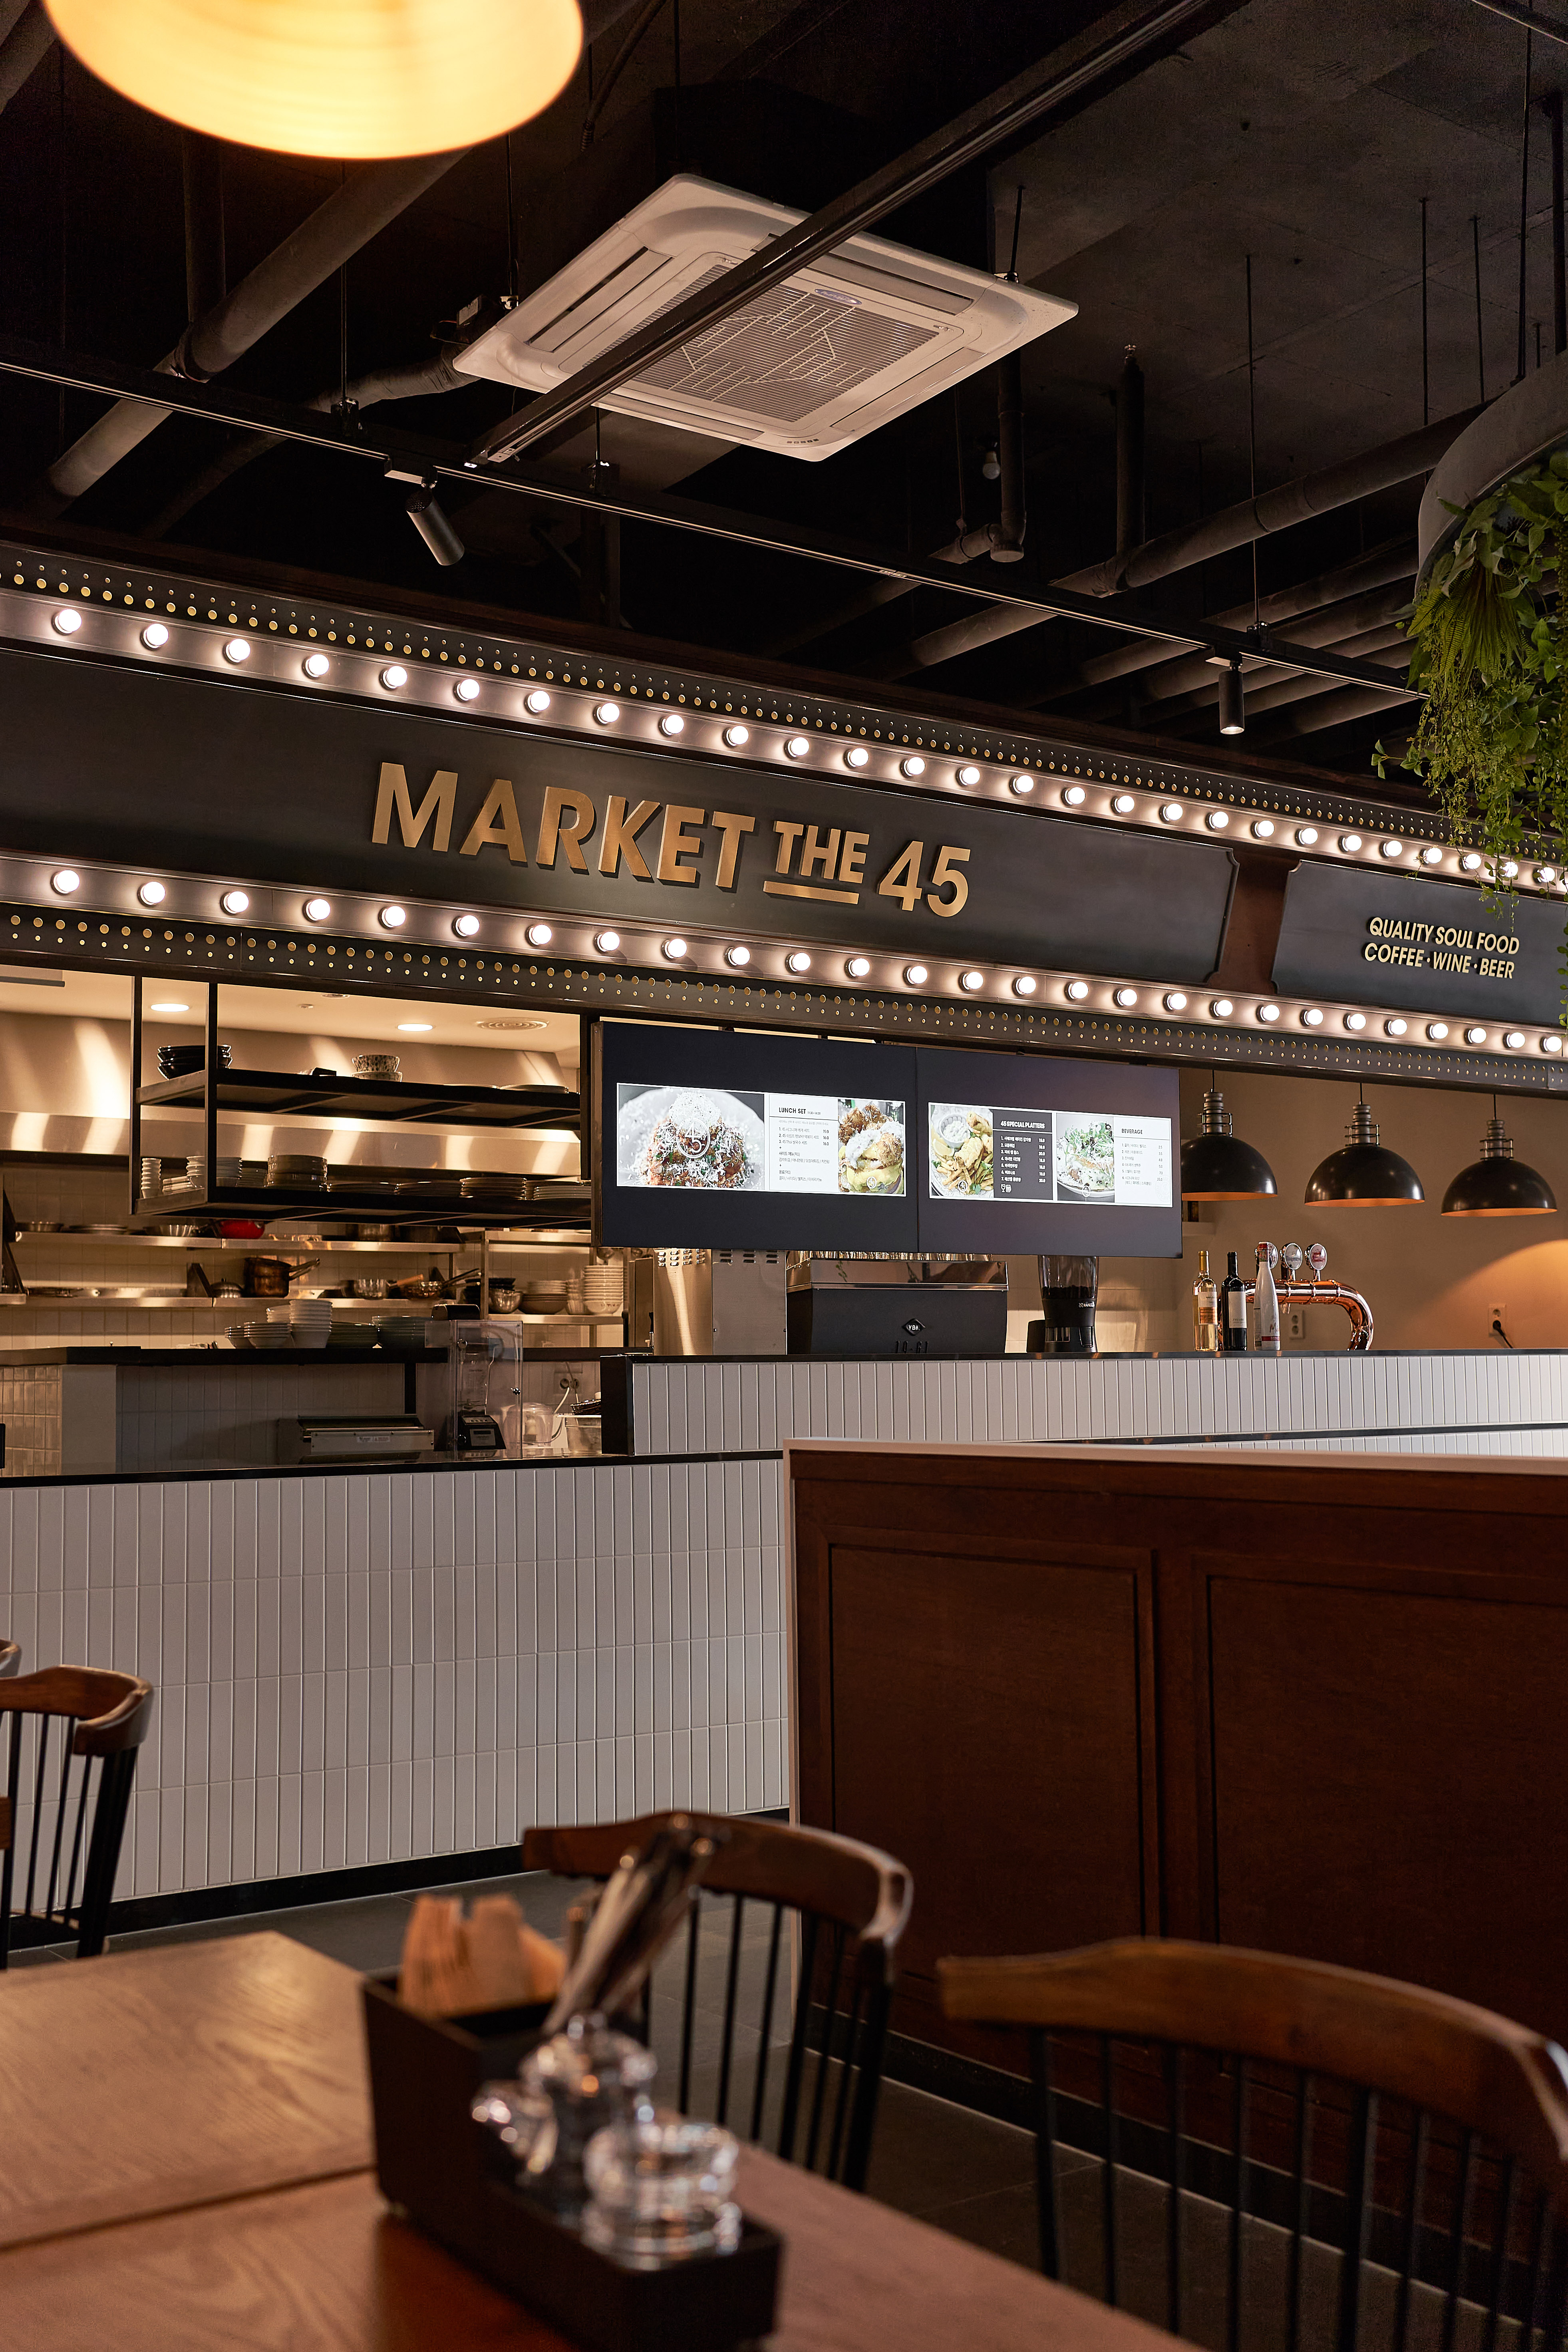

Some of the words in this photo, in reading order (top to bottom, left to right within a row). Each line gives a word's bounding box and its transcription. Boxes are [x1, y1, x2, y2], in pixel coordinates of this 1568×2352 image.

[372, 762, 755, 888] MARKET
[773, 821, 869, 884] THE
[879, 841, 971, 917] 45
[1370, 917, 1434, 942] QUALITY
[1435, 926, 1473, 949] SOUL
[1476, 932, 1519, 954] FOOD
[1365, 942, 1425, 967] COFFEE
[1433, 952, 1471, 973] WINE
[1479, 958, 1515, 979] BEER
